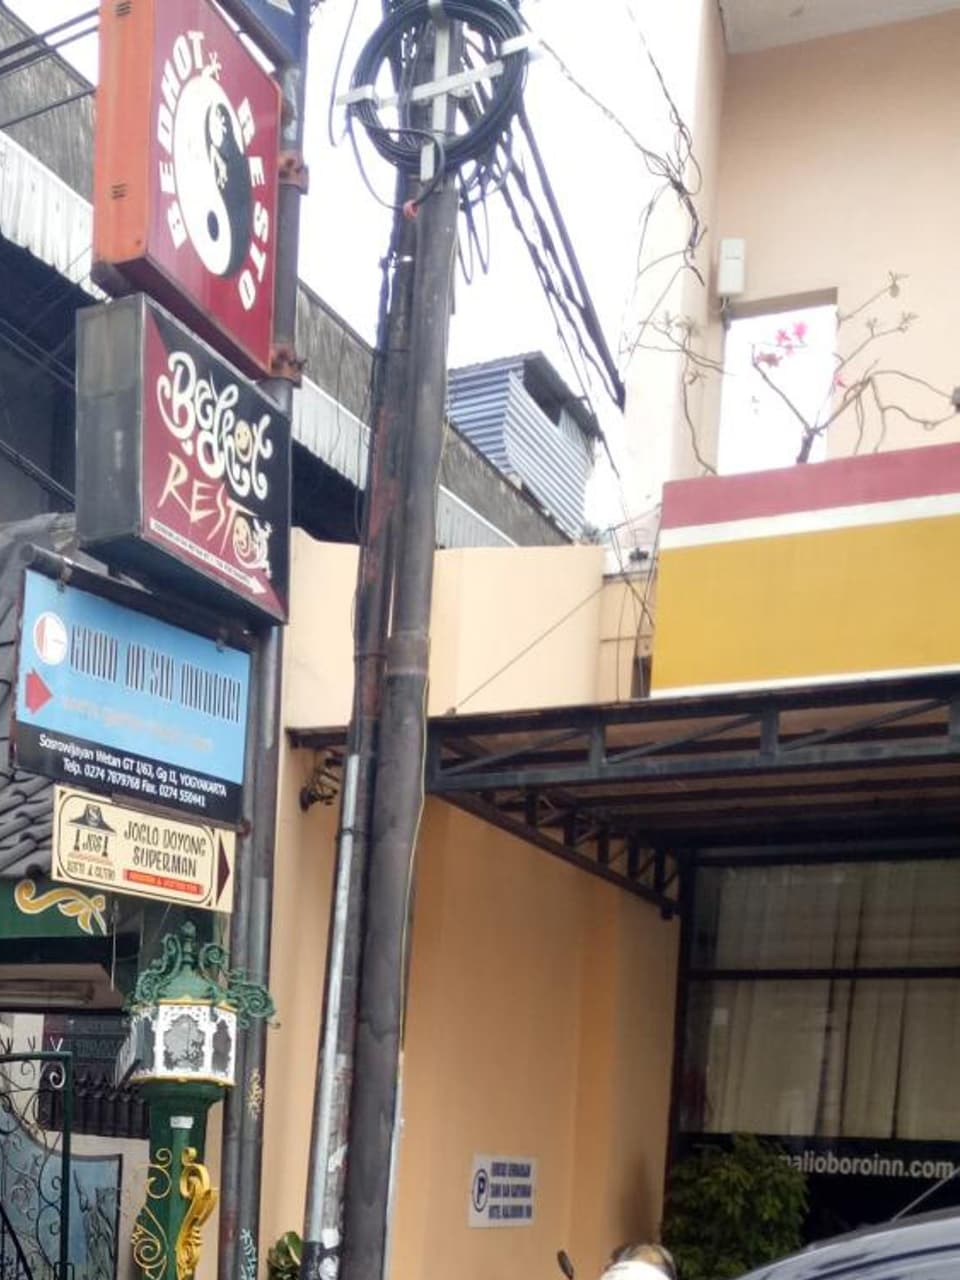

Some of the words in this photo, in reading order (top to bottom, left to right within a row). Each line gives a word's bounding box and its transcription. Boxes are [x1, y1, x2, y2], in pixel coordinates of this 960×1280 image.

[157, 30, 205, 250] BEDHOT
[237, 96, 269, 312] RESTO
[84, 763, 106, 781] 0274
[159, 783, 178, 800] 0274
[122, 757, 135, 772] GT
[156, 766, 168, 783] Gg
[179, 774, 227, 797] YOGYAKARTA
[124, 820, 159, 847] JOGLO
[163, 827, 207, 857] DOYONG
[132, 846, 197, 878] SUPERMAN
